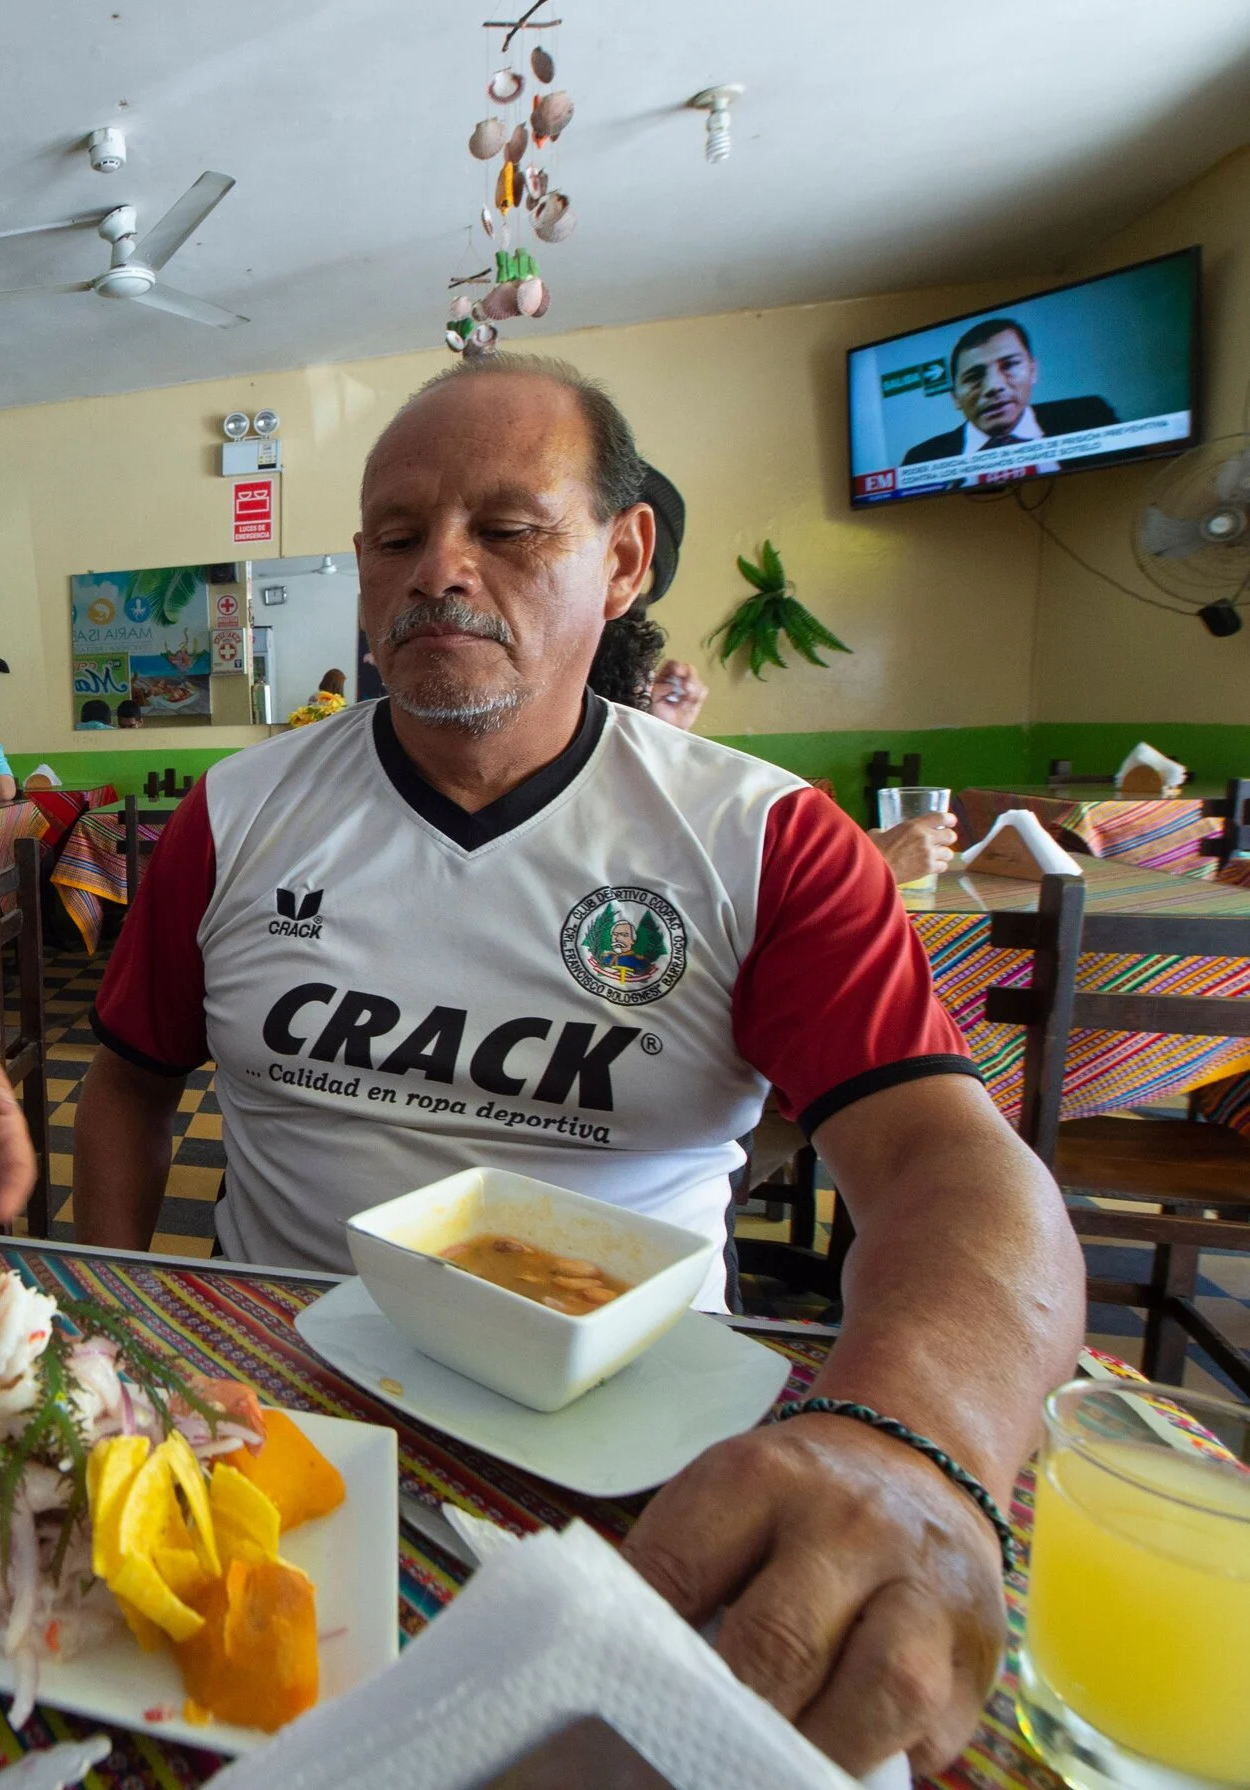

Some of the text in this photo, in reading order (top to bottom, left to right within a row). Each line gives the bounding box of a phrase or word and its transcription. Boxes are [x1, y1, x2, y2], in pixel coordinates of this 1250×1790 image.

[864, 472, 893, 491] EM
[268, 920, 323, 939] CRACK
[572, 889, 681, 931] CLUB DERTIVO COOPAC
[564, 948, 605, 993] FRANCISCO
[662, 935, 684, 987] BARRANCO
[262, 982, 642, 1112] CRACK
[268, 1063, 360, 1098] Calidad
[367, 1085, 397, 1103] en
[407, 1092, 467, 1117] ropa
[476, 1101, 610, 1144] deportiva
